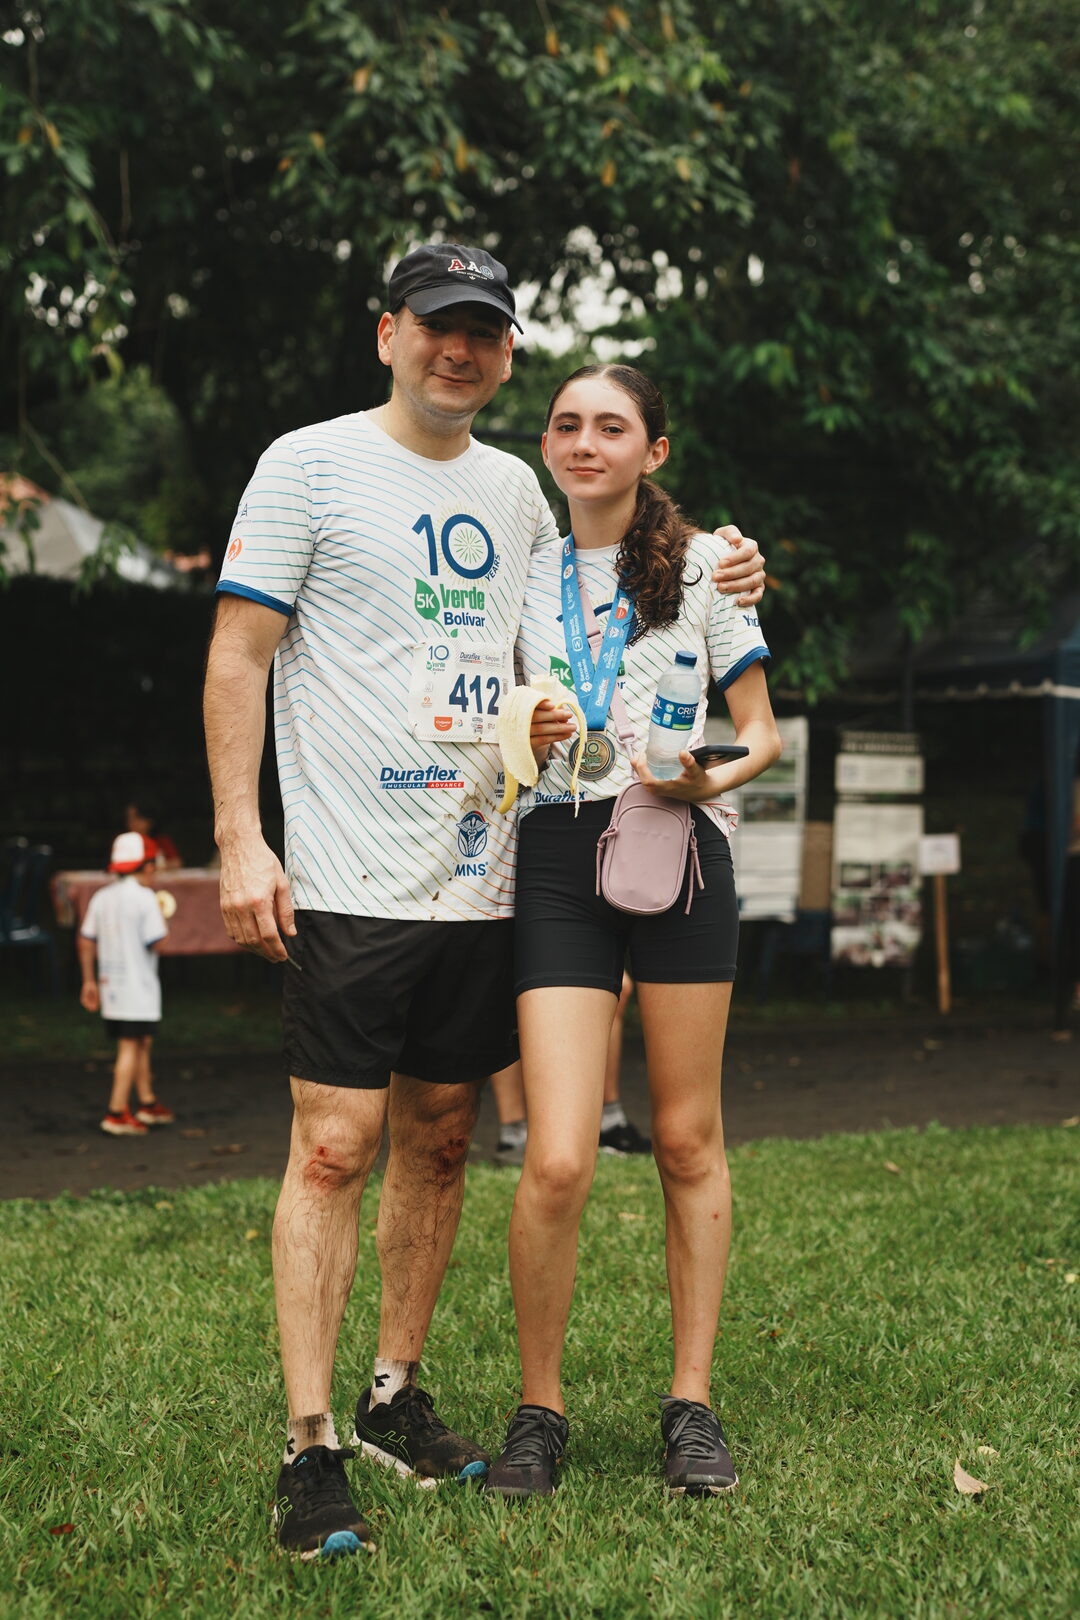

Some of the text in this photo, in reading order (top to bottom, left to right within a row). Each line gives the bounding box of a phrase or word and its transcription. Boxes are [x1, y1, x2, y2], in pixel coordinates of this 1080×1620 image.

[412, 514, 495, 580] 10
[485, 553, 501, 582] YEARS
[416, 593, 435, 609] 5K
[439, 583, 485, 610] Verde
[443, 612, 485, 627] Bolívar
[428, 645, 449, 661] 10
[551, 668, 571, 681] 5K
[449, 673, 500, 715] 412
[380, 765, 458, 781] Duraflex
[454, 864, 487, 877] MNS
